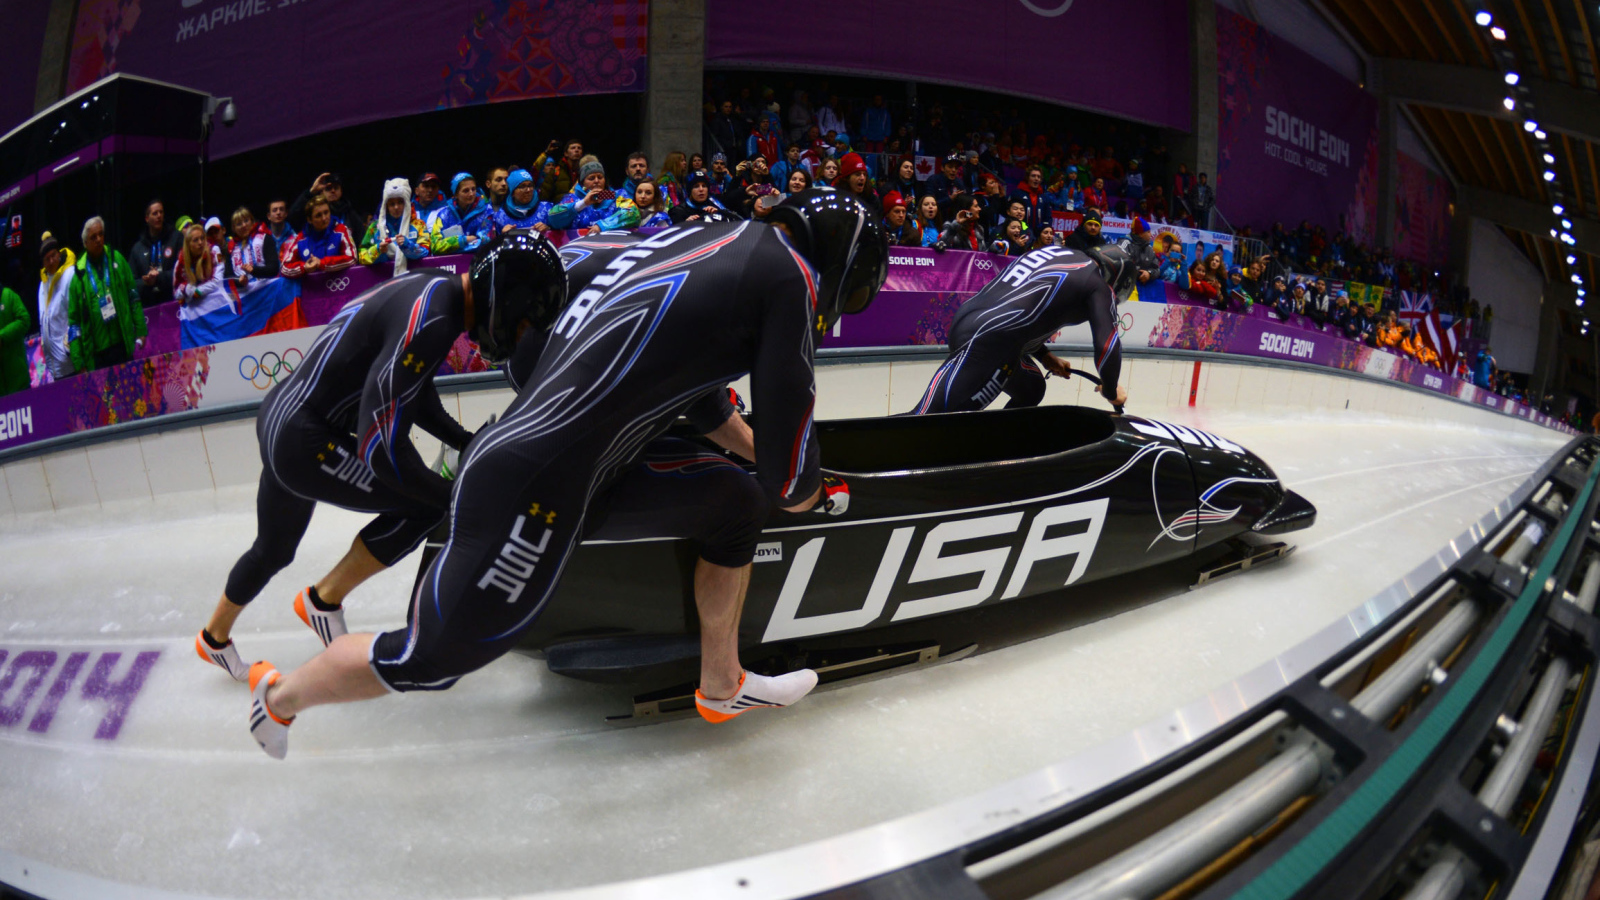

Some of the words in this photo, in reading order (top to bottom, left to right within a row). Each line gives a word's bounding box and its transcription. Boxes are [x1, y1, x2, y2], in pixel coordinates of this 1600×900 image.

[175, 0, 271, 43] ЖАРКИЕ.
[1265, 105, 1315, 152] SOCHI
[1319, 129, 1350, 168] 2014
[1102, 220, 1126, 229] МСКИЙ
[436, 264, 457, 274] 014
[889, 256, 914, 265] SOCHI
[915, 257, 935, 267] 2014
[1001, 245, 1075, 287] USA
[555, 226, 705, 340] USA
[1259, 331, 1292, 354] SOCHI
[1293, 338, 1315, 359] 2014
[0, 405, 34, 441] 2014
[477, 514, 553, 603] USA
[762, 497, 1110, 643] USA
[0, 650, 161, 740] 014
